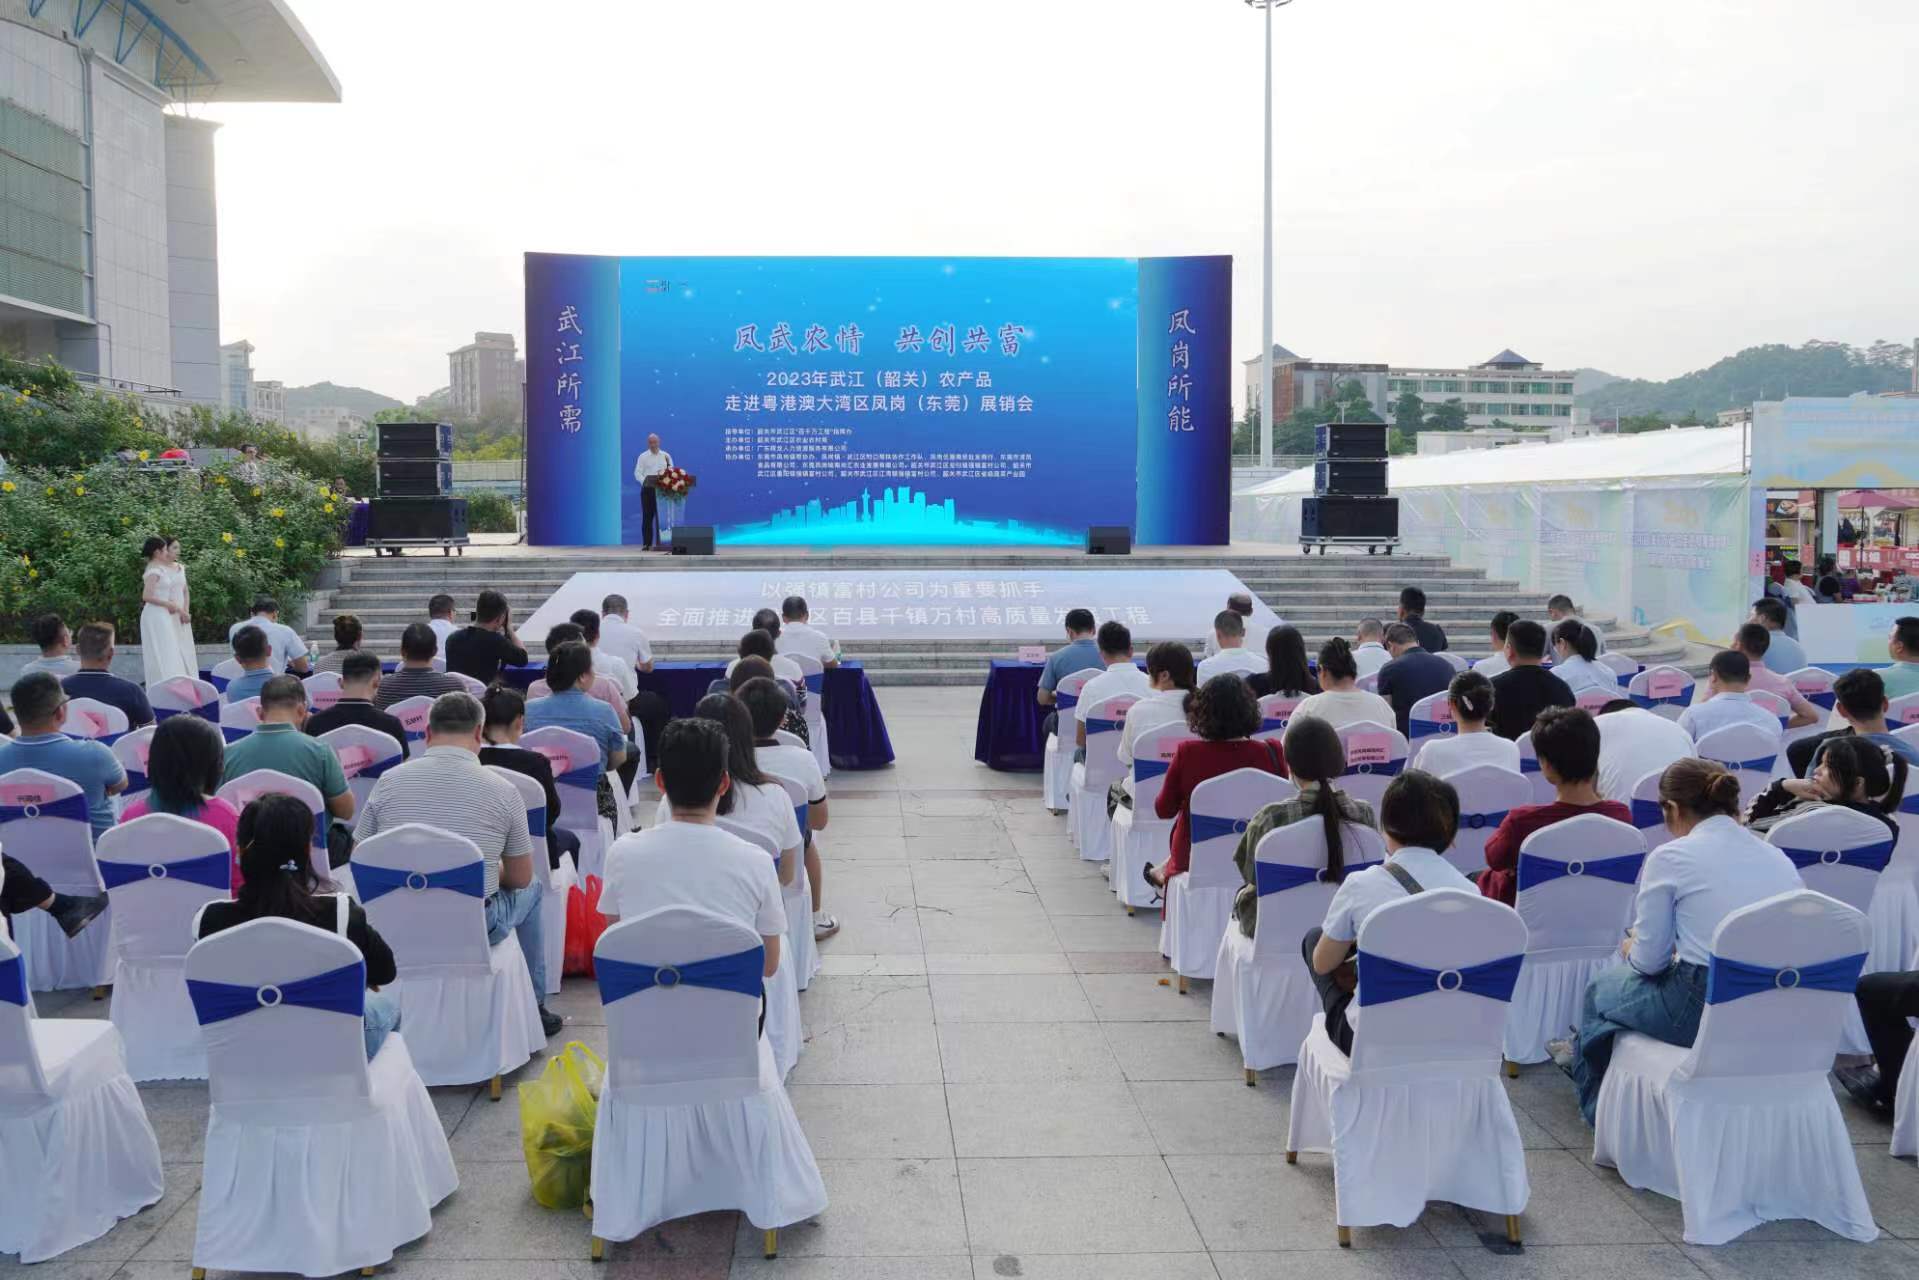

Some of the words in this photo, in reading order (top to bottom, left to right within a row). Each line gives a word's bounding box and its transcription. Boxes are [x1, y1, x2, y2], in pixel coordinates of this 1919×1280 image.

[733, 322, 865, 353] 凤武农情
[896, 322, 1026, 355] 共创共富
[556, 305, 584, 434] 武江所需
[767, 371, 992, 388] 2023年武江（韶关）农产品
[1168, 309, 1197, 433] 凤岗所能
[724, 394, 1034, 412] 走进粤港澳大湾区凤岗（东莞）展销会
[760, 581, 1045, 599] 以强镇富村公司为重要抓手
